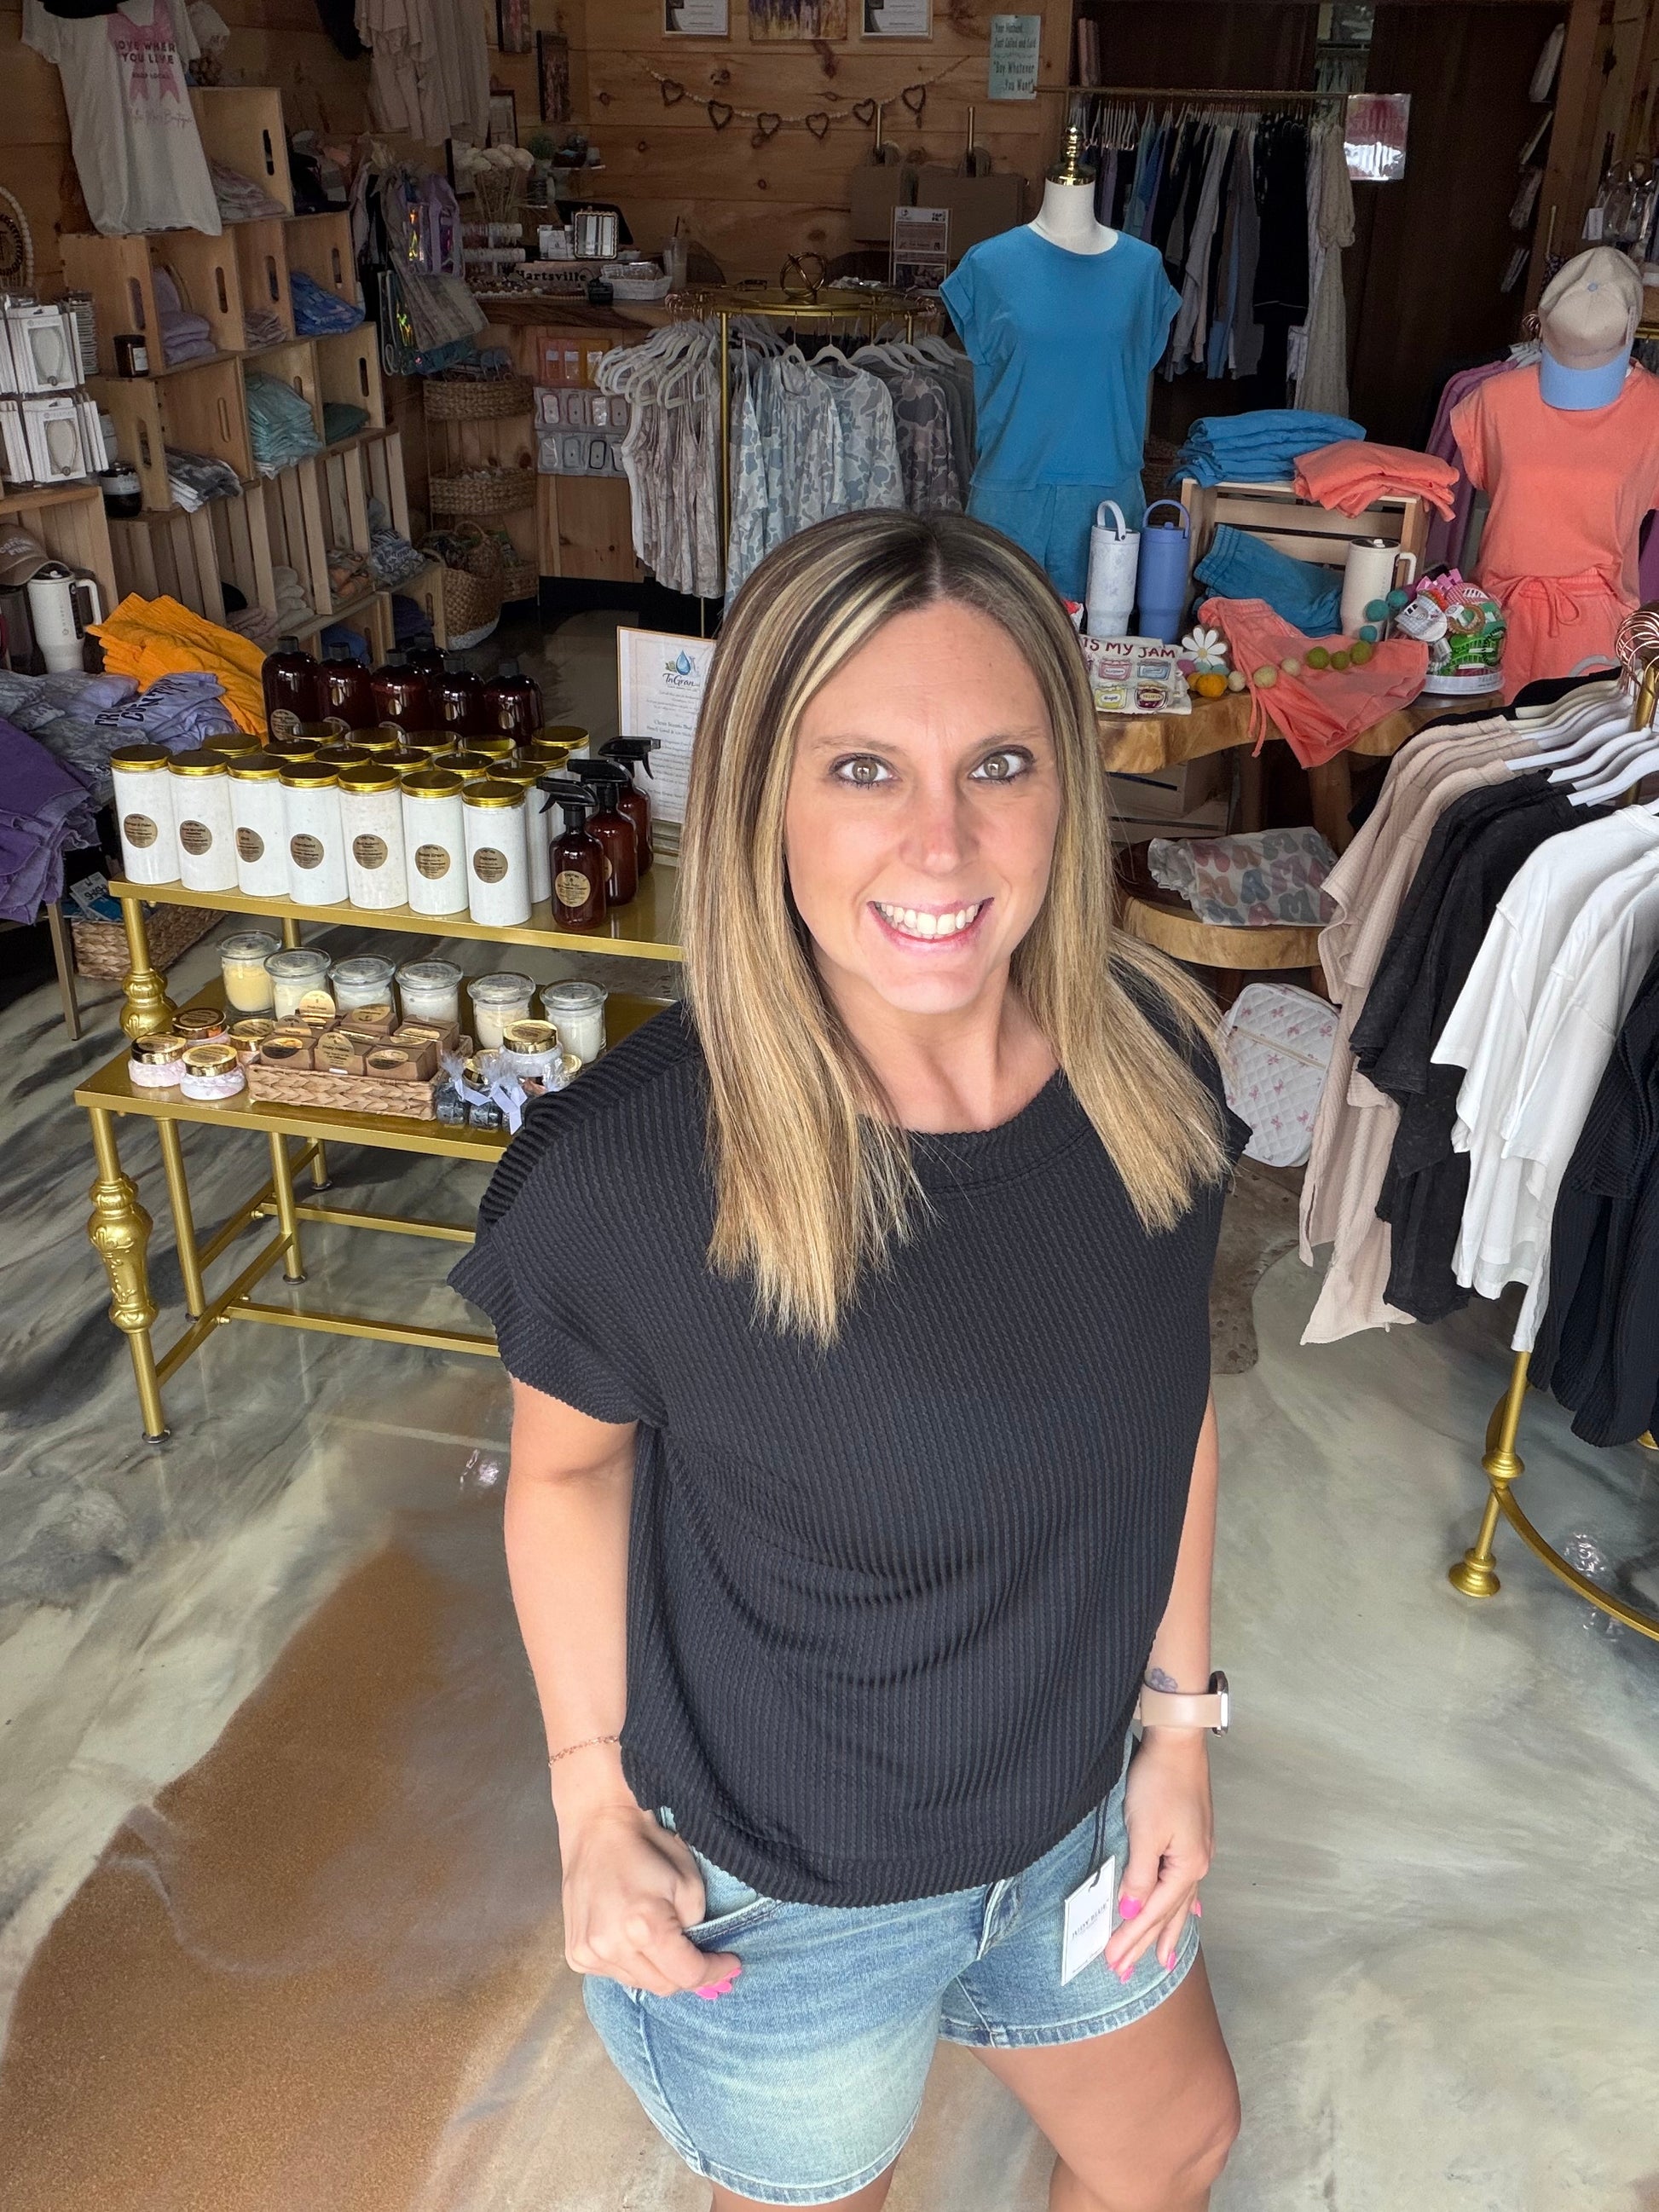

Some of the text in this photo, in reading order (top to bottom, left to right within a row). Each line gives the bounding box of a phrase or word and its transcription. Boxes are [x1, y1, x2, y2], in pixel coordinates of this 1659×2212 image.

[144, 41, 176, 52] WHER
[122, 53, 174, 64] YOU LIVE
[516, 269, 587, 282] Hartsville
[1083, 637, 1176, 659] IS MY JAM
